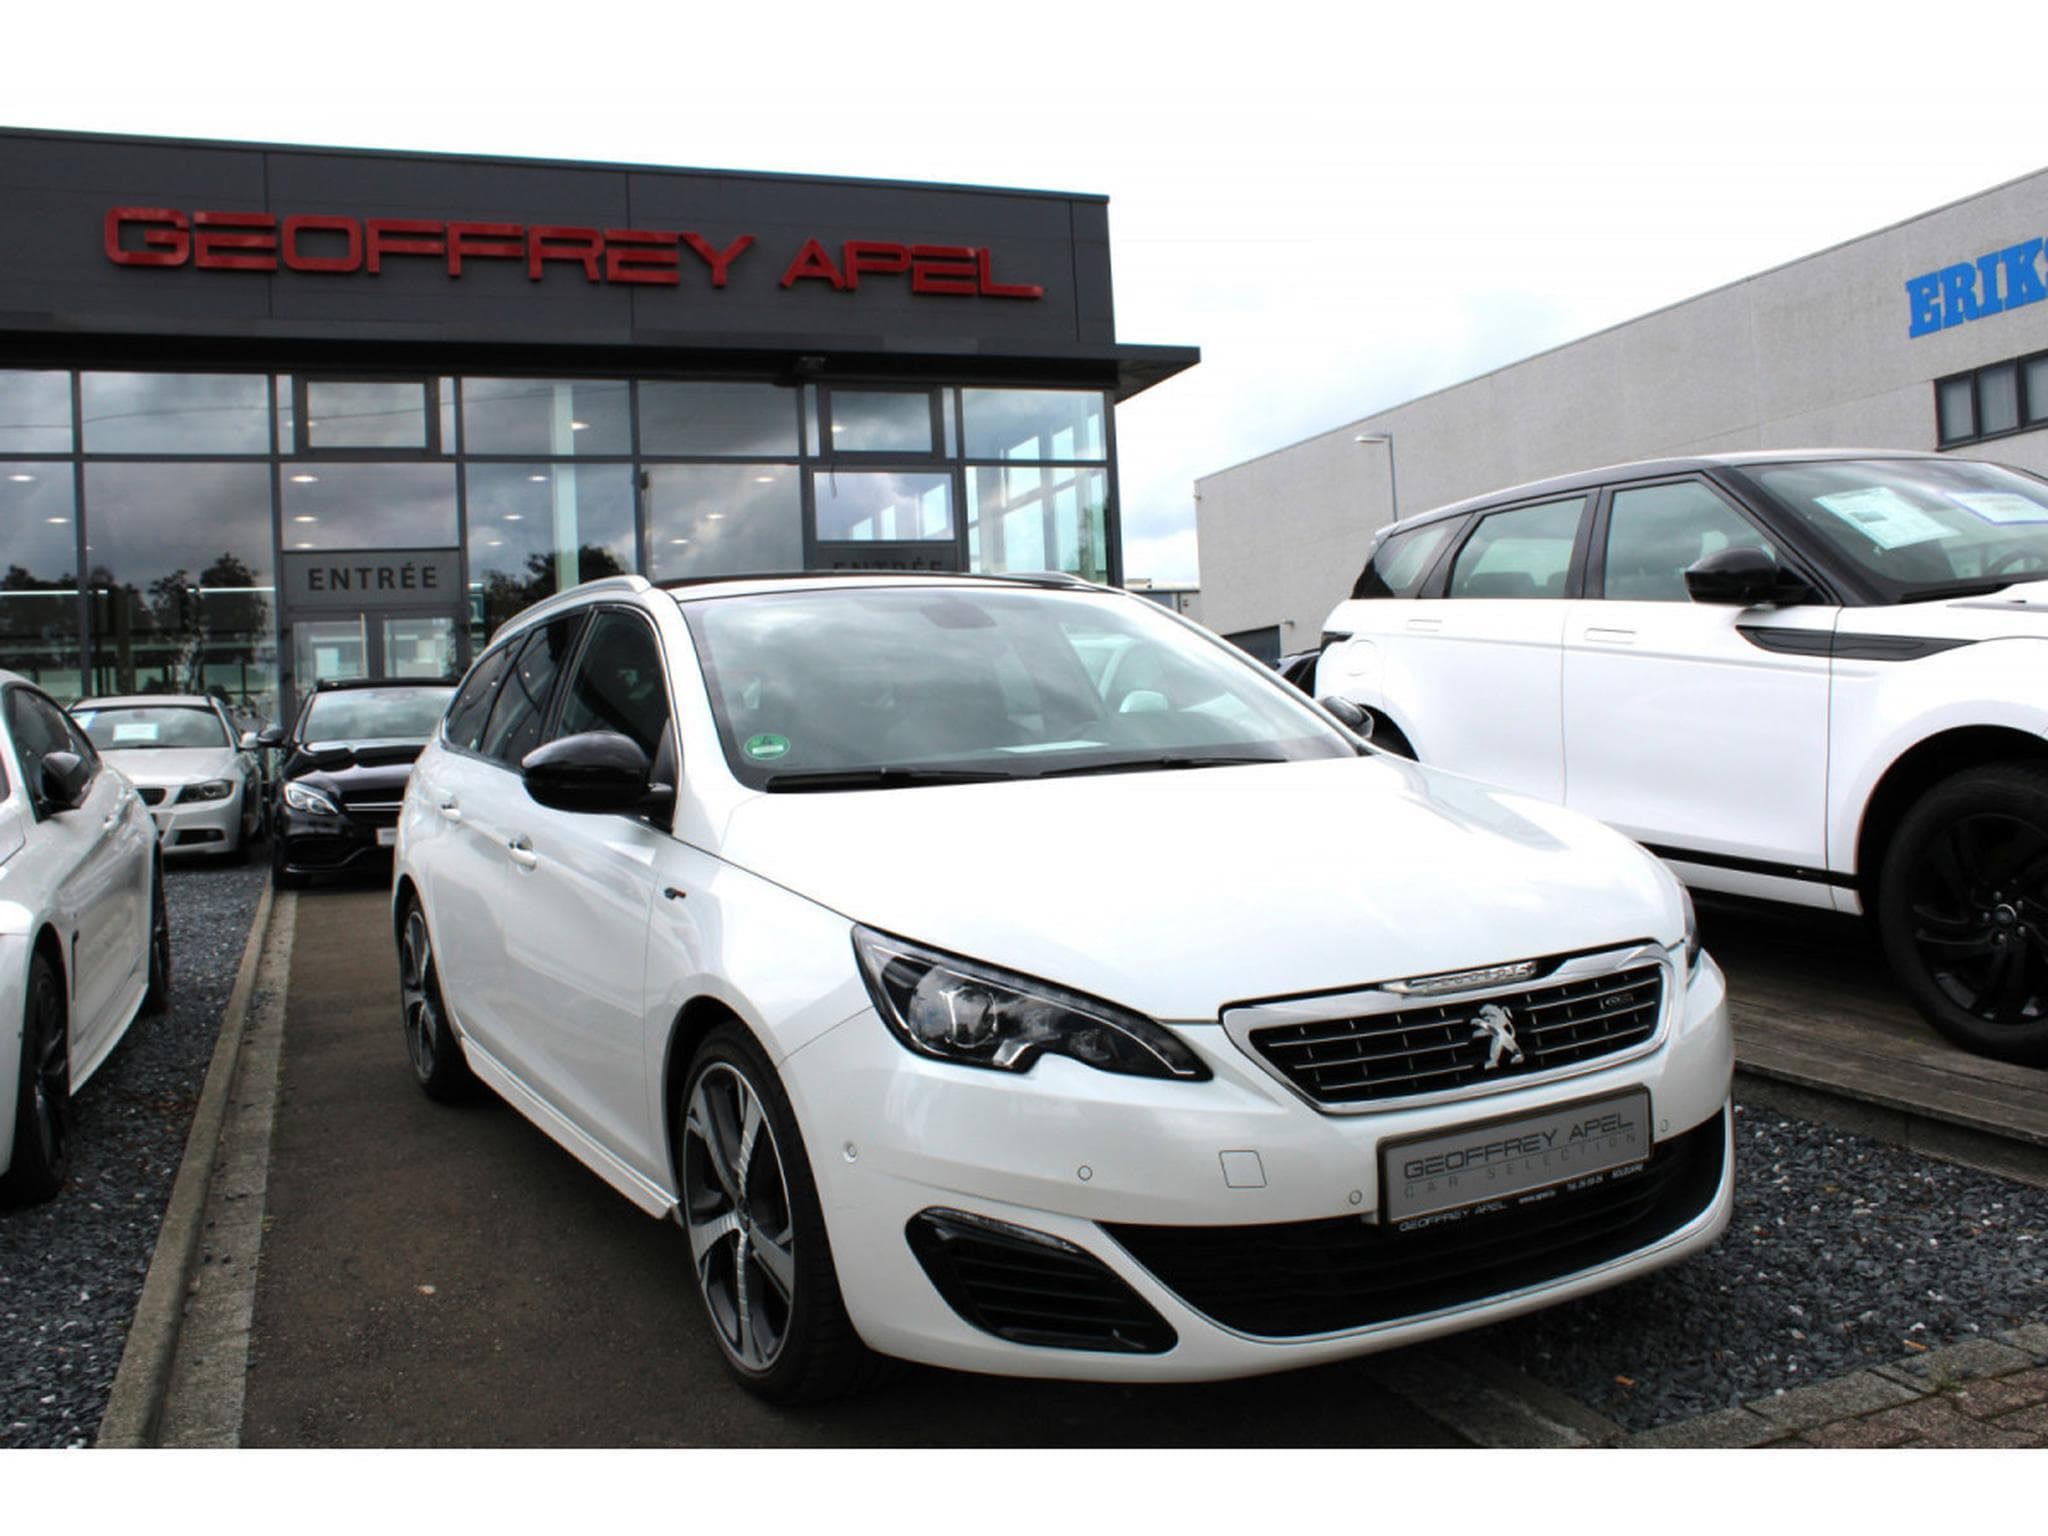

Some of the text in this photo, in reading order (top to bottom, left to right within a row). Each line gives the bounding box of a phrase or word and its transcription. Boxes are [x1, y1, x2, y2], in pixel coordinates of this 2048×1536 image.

[104, 206, 1044, 299] GEOFFREY APEL
[1905, 235, 2048, 339] ERIK
[308, 562, 437, 591] ENTRÉE
[1404, 1112, 1635, 1180] GEOFFREY APEL
